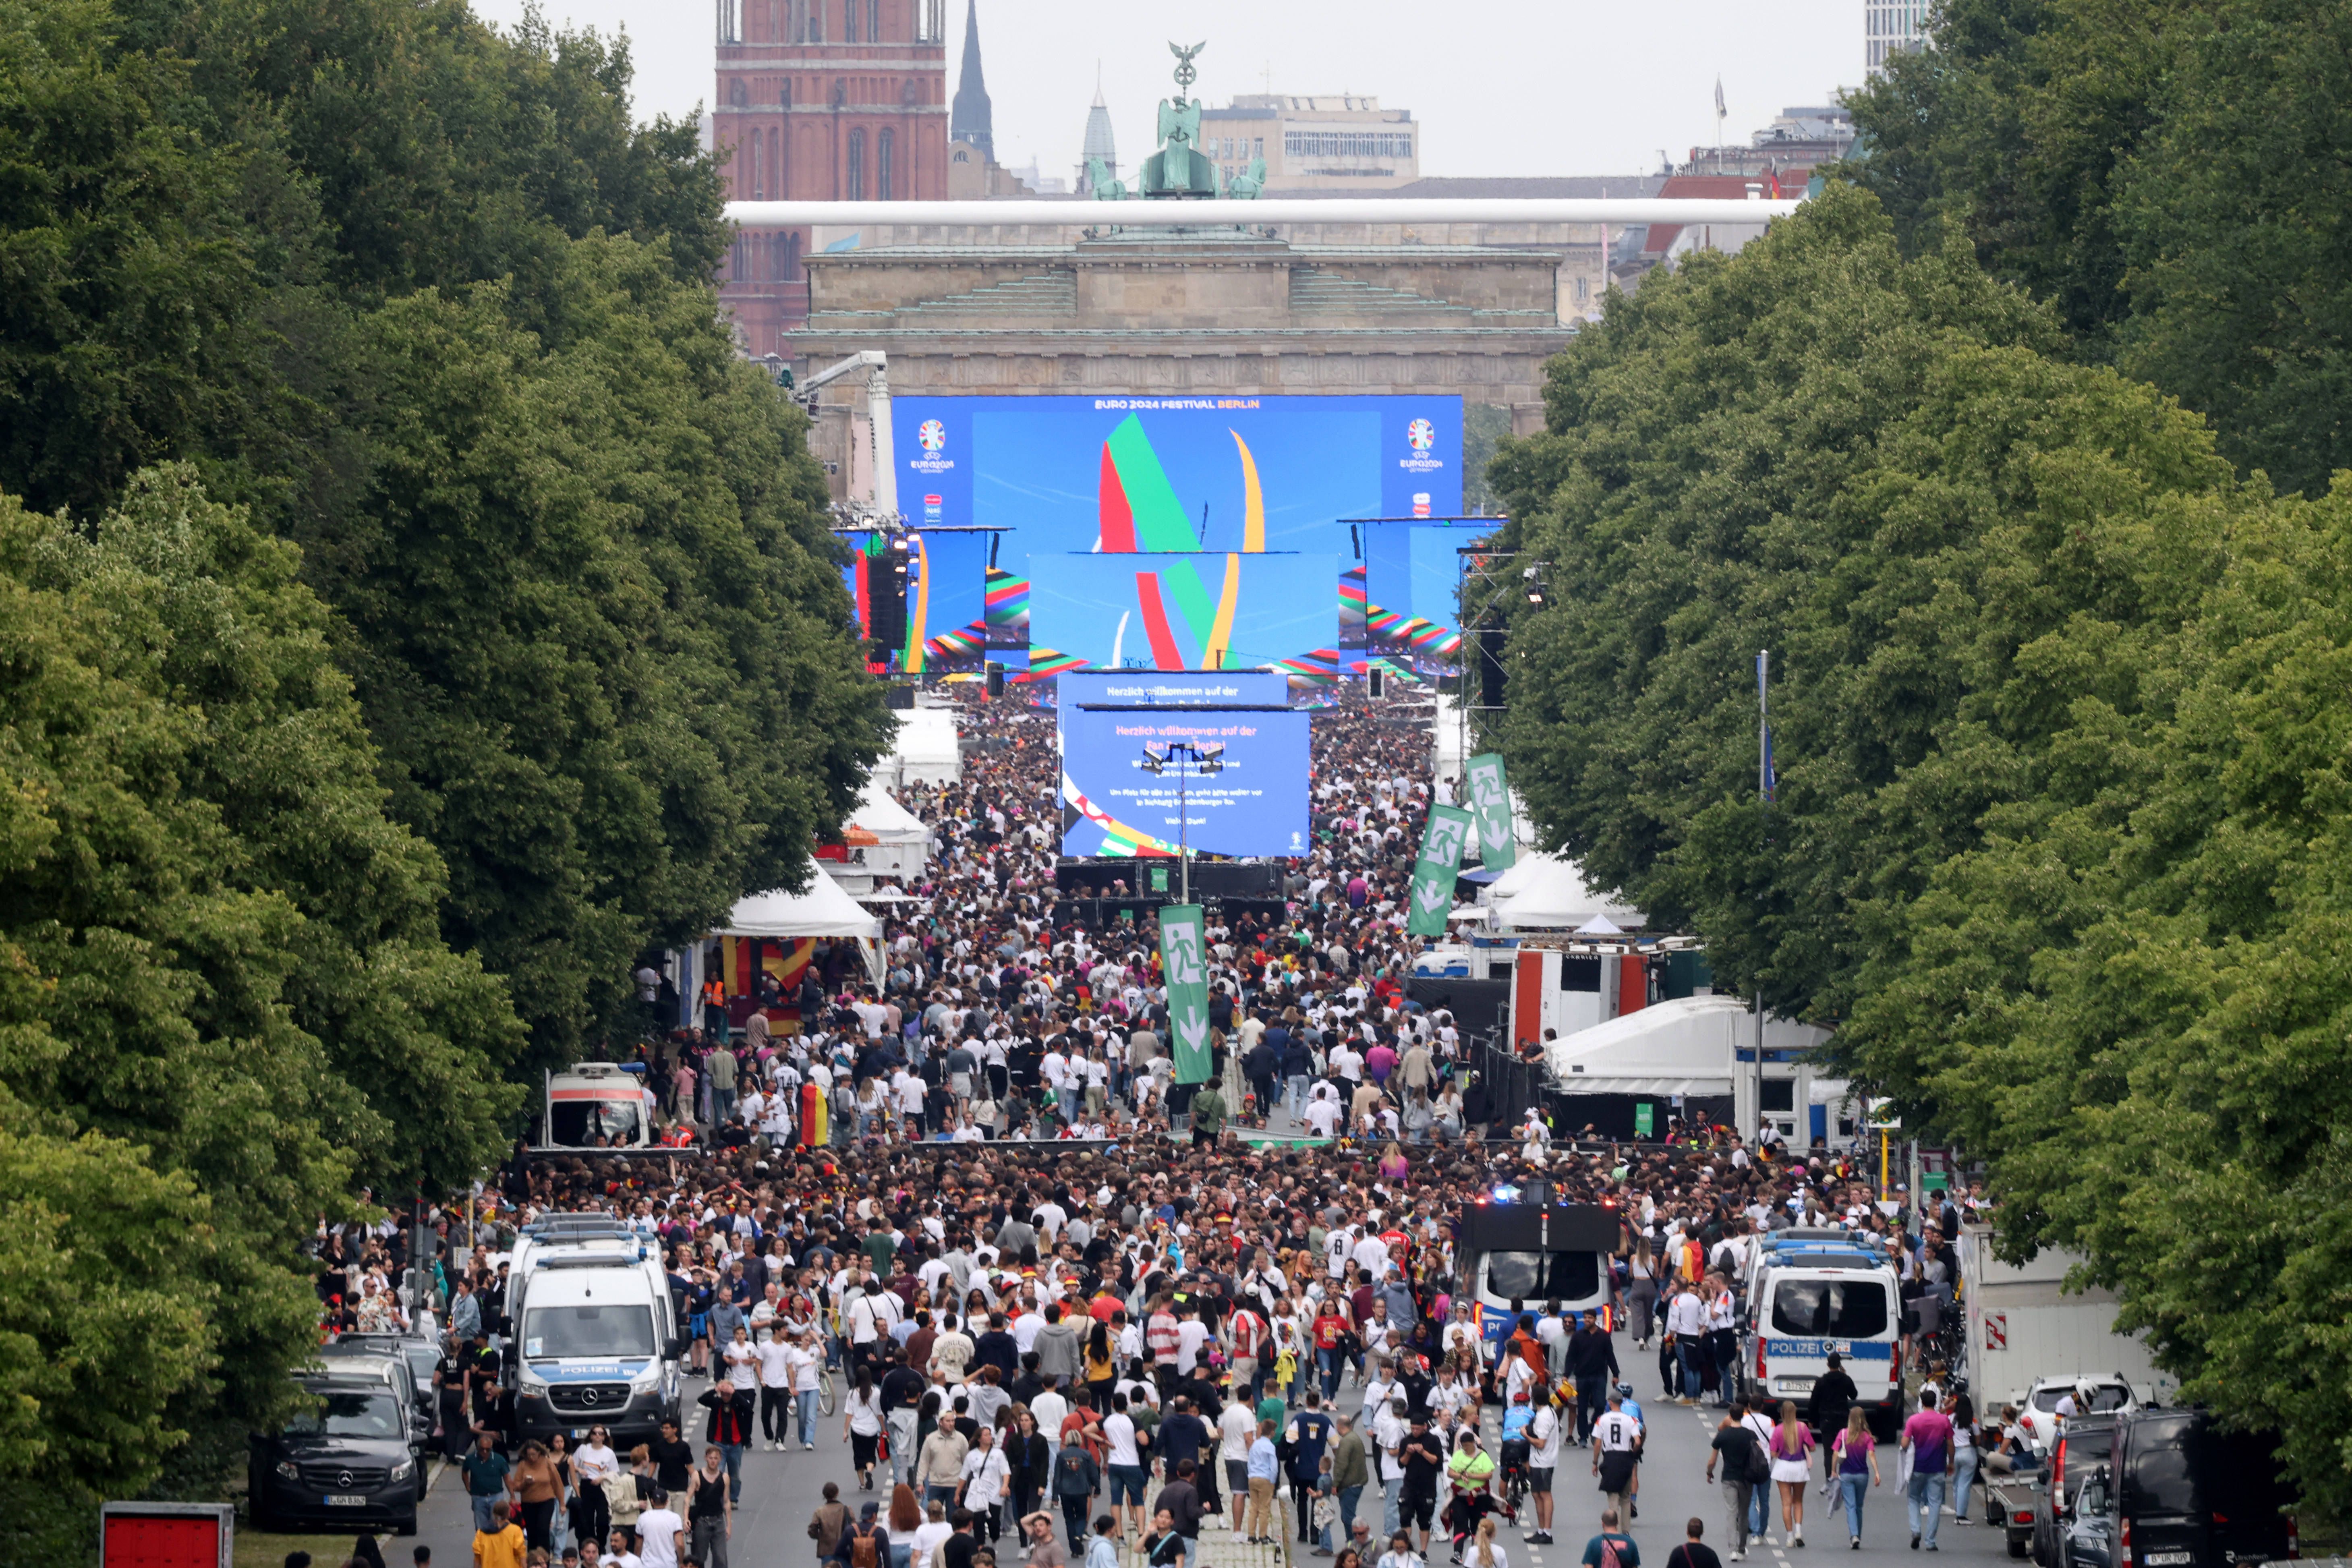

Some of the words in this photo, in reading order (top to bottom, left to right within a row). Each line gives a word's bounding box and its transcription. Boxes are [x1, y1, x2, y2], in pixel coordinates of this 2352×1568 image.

[1095, 400, 1127, 409] EURO
[1129, 400, 1159, 409] 2024
[1161, 400, 1216, 409] FESTIVAL
[1218, 400, 1260, 409] BERLIN
[1107, 687, 1144, 696] Herzlich
[1204, 686, 1221, 696] auf
[1222, 686, 1239, 696] der
[1116, 725, 1156, 736] Herzlich
[1157, 725, 1218, 736] willkommen
[1221, 725, 1237, 736] auf
[1239, 725, 1257, 736] der
[1147, 740, 1164, 750] Fan
[1335, 1239, 1343, 1255] 8
[1771, 1342, 1819, 1354] POLIZEI
[446, 1359, 457, 1369] 10
[561, 1366, 618, 1375] POLIZEI
[1611, 1423, 1621, 1444] 8
